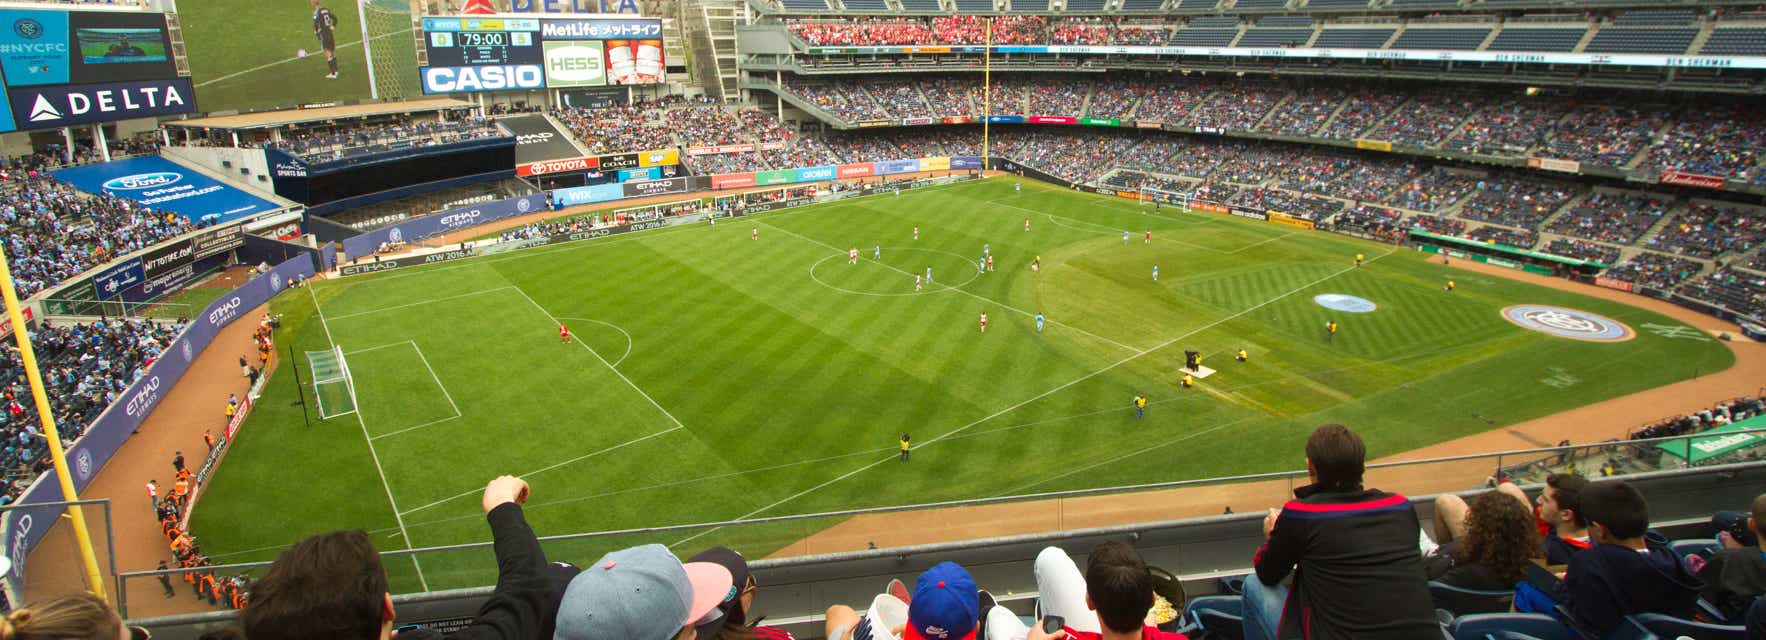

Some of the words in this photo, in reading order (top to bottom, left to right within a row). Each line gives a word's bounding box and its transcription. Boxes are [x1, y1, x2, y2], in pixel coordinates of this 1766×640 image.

[542, 22, 598, 36] MetLife
[464, 34, 502, 45] 79:00
[550, 58, 599, 70] HESS
[426, 64, 542, 91] CASIO
[68, 86, 184, 115] DELTA
[546, 160, 588, 173] TOYOTA
[602, 159, 636, 168] COACH
[120, 174, 170, 188] Ford
[636, 180, 672, 190] ETIHAD
[1663, 174, 1724, 188] Budweiser
[568, 191, 591, 200] WIX
[440, 210, 480, 225] ETIHAD
[569, 229, 610, 240] ETIHAD
[425, 252, 445, 263] ATW
[446, 251, 464, 260] 2016
[343, 260, 398, 275] ETIHAD
[210, 297, 240, 324] ETIHAD
[126, 376, 160, 416] ETIHAD
[13, 514, 32, 577] ETIHAD
